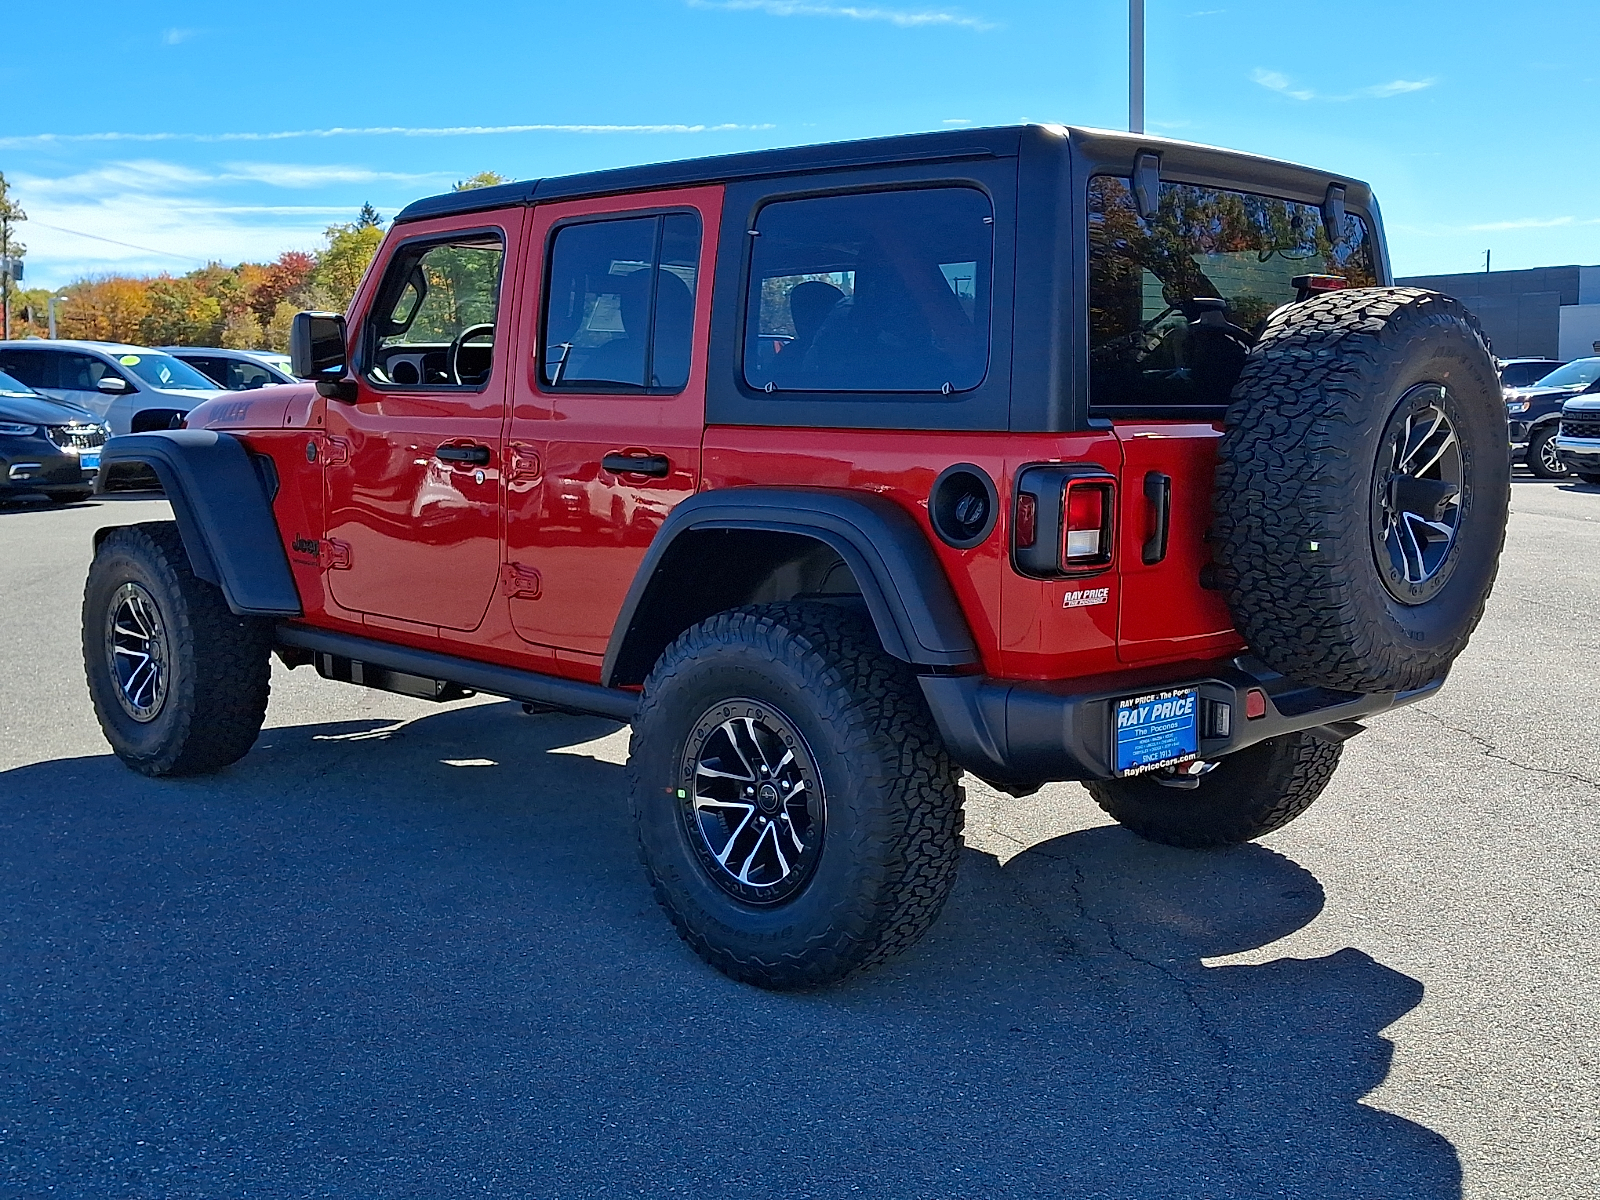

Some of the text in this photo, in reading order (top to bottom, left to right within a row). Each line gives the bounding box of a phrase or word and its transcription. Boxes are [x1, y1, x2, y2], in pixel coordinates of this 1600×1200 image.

[292, 532, 320, 558] Jeep
[1065, 588, 1109, 601] RAY PRICE
[1120, 700, 1134, 708] RAY
[1135, 695, 1156, 705] PRICE
[1160, 692, 1172, 700] The
[1118, 697, 1195, 728] RAY PRICE
[1151, 722, 1178, 733] Poconos
[1143, 750, 1172, 763] SINCE 1913
[1124, 753, 1196, 777] RayPriceCars.com
